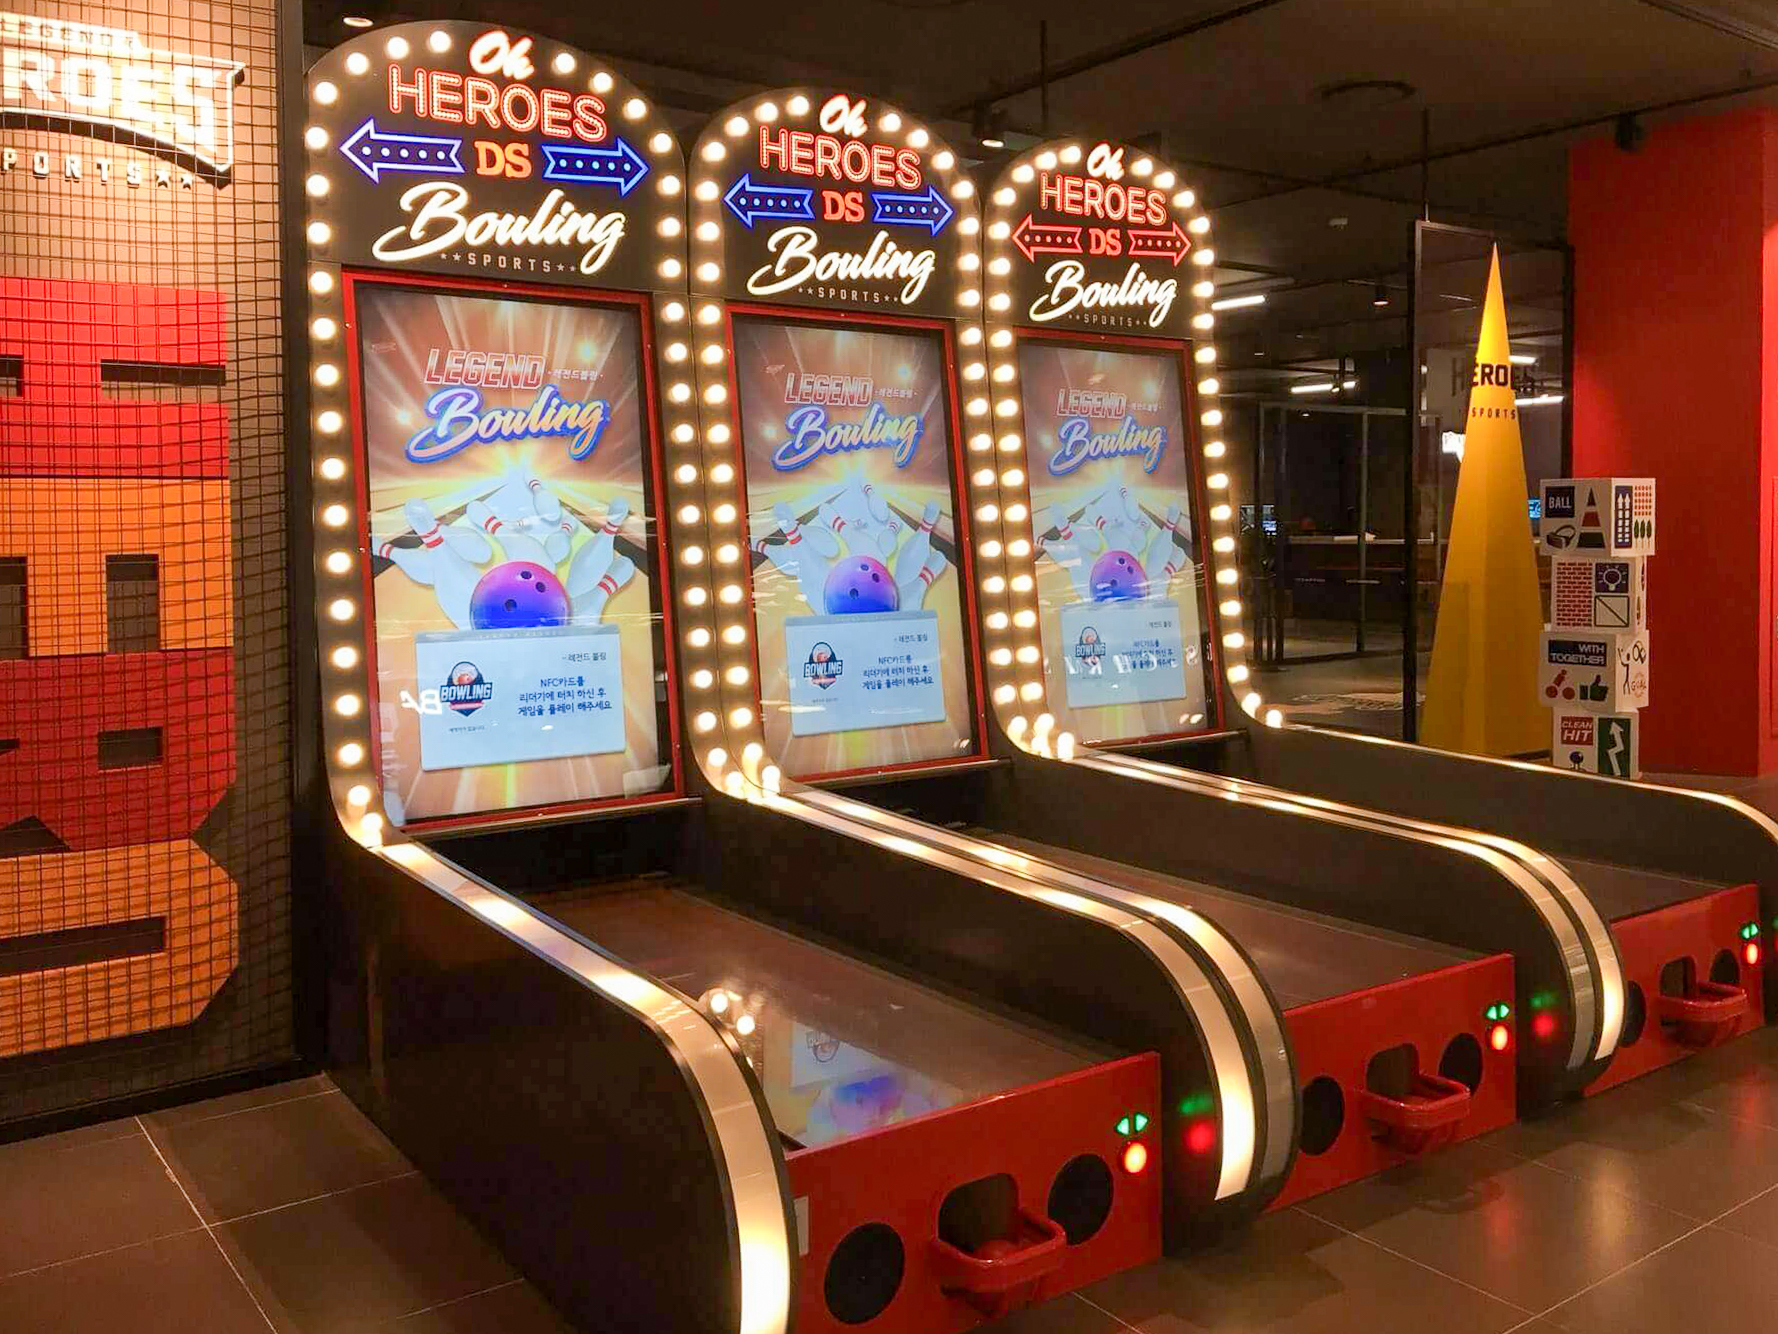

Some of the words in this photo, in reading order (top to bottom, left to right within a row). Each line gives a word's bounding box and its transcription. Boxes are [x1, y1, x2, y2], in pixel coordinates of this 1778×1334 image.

[388, 63, 607, 142] HEROES
[474, 141, 532, 178] DS
[759, 125, 922, 190] HEROES
[822, 190, 865, 223] DS
[1041, 172, 1166, 226] HEROES
[371, 181, 626, 275] Bowling
[1089, 228, 1122, 256] DS
[468, 252, 551, 272] SPORTS
[746, 226, 936, 305] Bowling
[818, 287, 880, 303] SPORTS
[1029, 259, 1178, 328] Bowling
[424, 348, 547, 390] LEGEND
[784, 372, 874, 407] LEGEND
[1057, 389, 1127, 419] LEGEND
[406, 384, 609, 461] Bowling
[1471, 407, 1516, 420] SPORTS
[773, 403, 922, 471] Bowling
[1049, 416, 1166, 474] Bowling
[1548, 497, 1572, 509] BALL
[1550, 653, 1604, 664] TOGETHER
[1579, 644, 1604, 653] WITH
[804, 660, 843, 678] BOWLING
[440, 682, 493, 702] BOWLING
[1562, 721, 1593, 729] CLEAN
[1563, 730, 1593, 742] HIT
